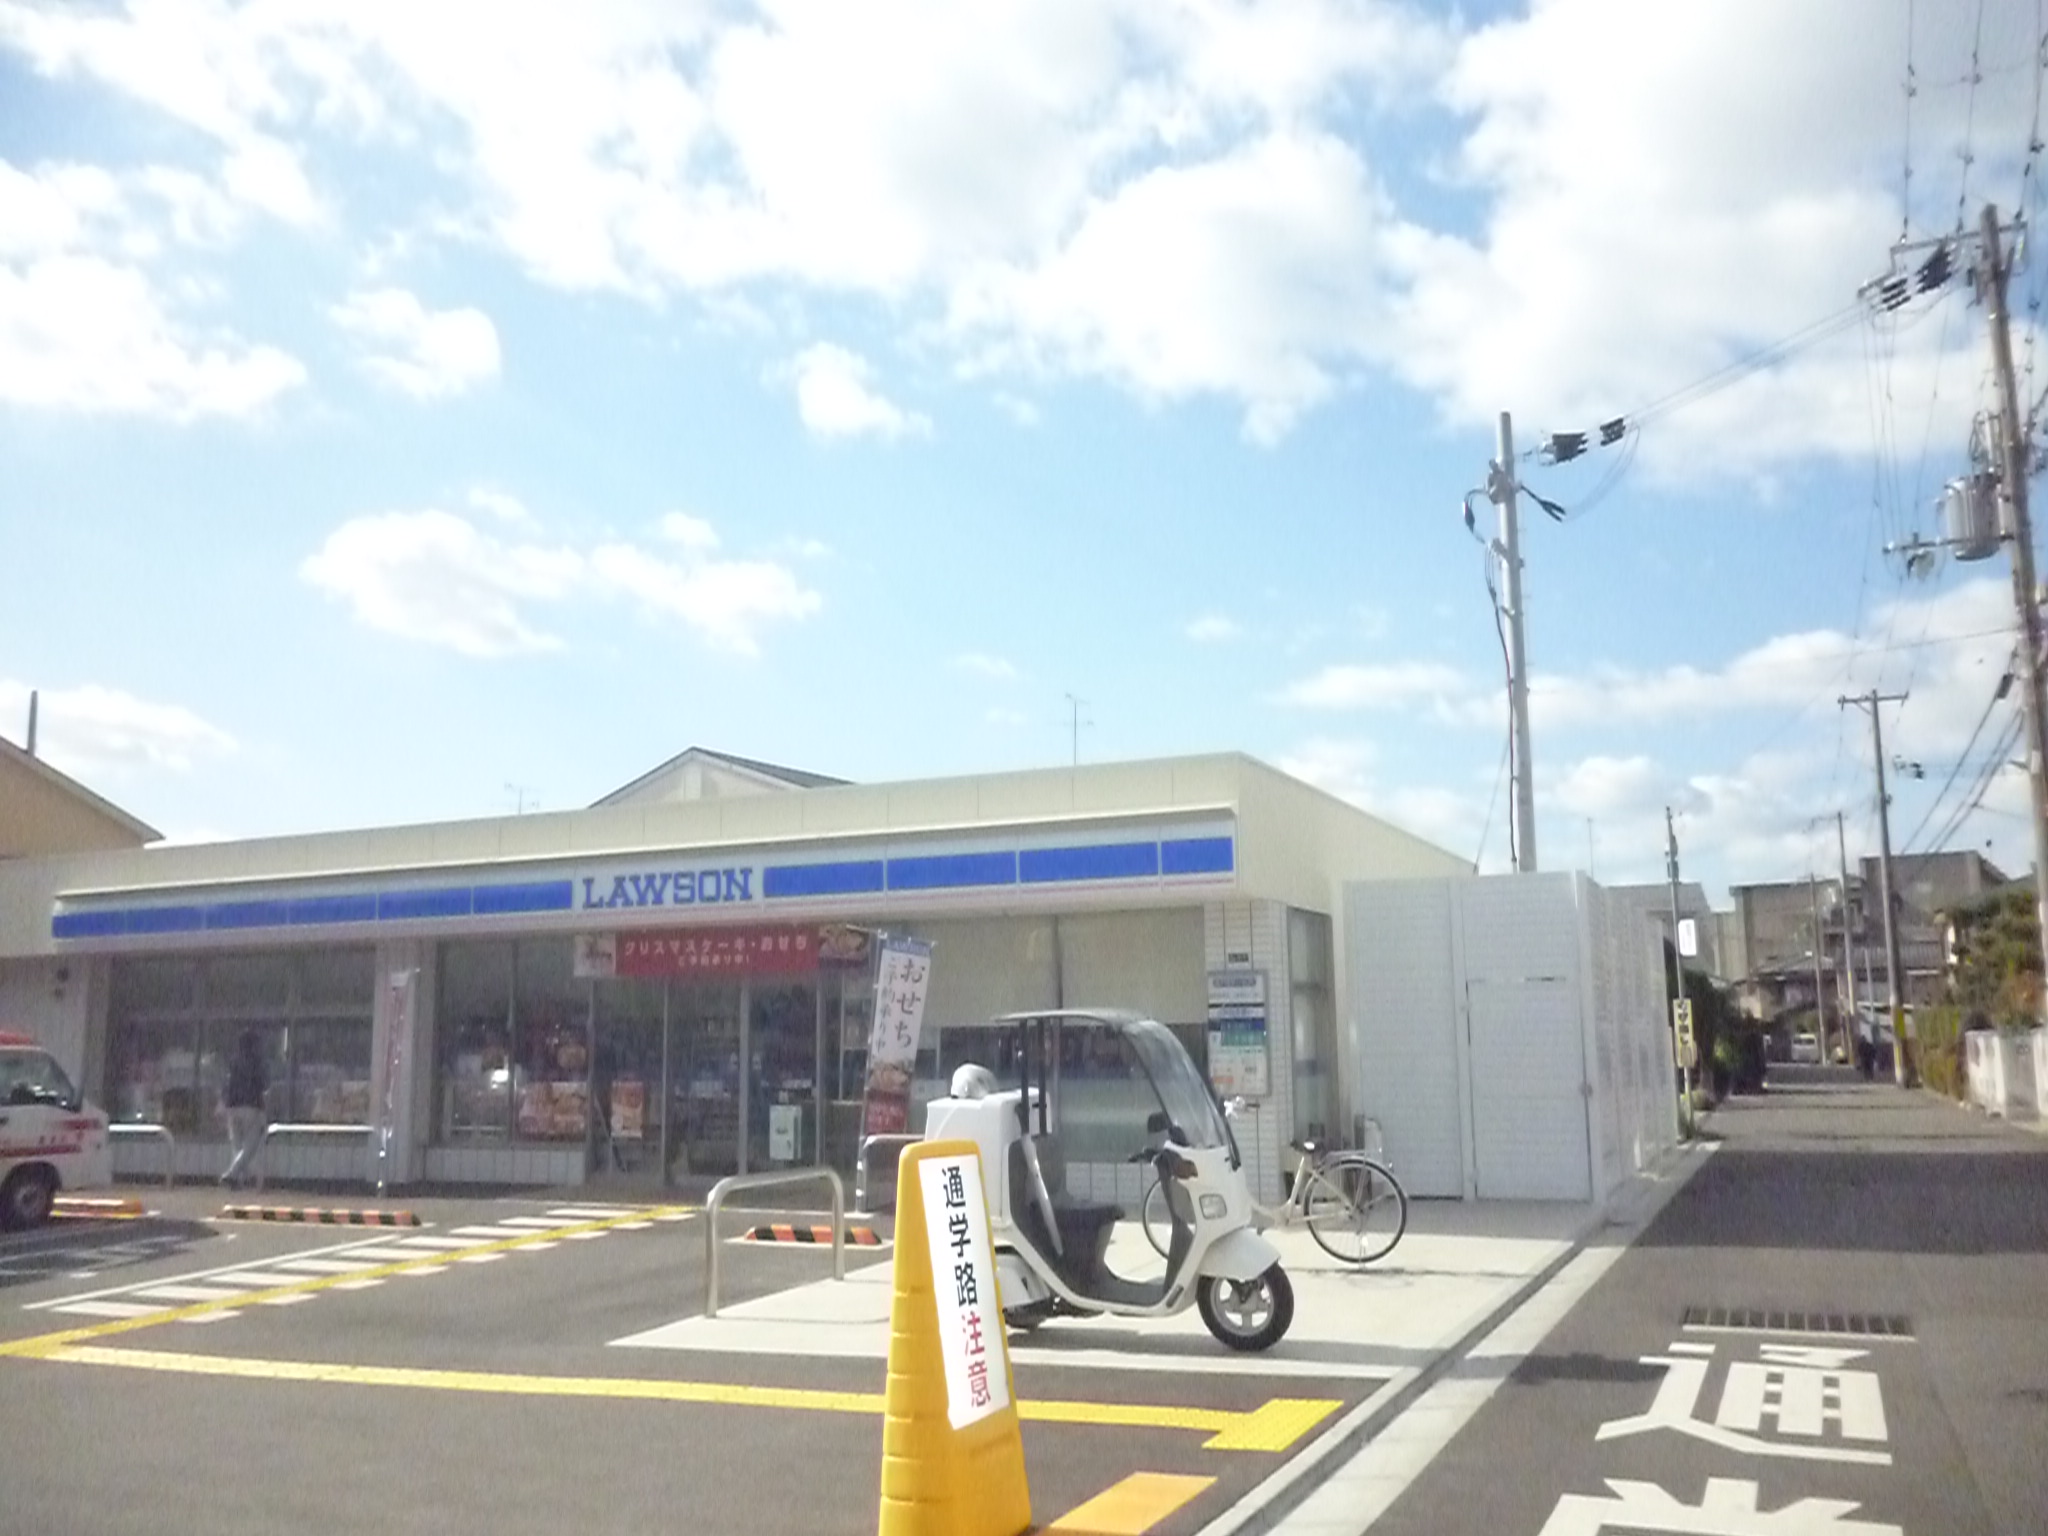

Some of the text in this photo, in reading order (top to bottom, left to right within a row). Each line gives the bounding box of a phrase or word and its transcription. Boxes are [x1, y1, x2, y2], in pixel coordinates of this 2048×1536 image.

[582, 866, 753, 909] LAWSON
[894, 957, 926, 1049] おせち
[941, 1165, 992, 1409] 通学路注意
